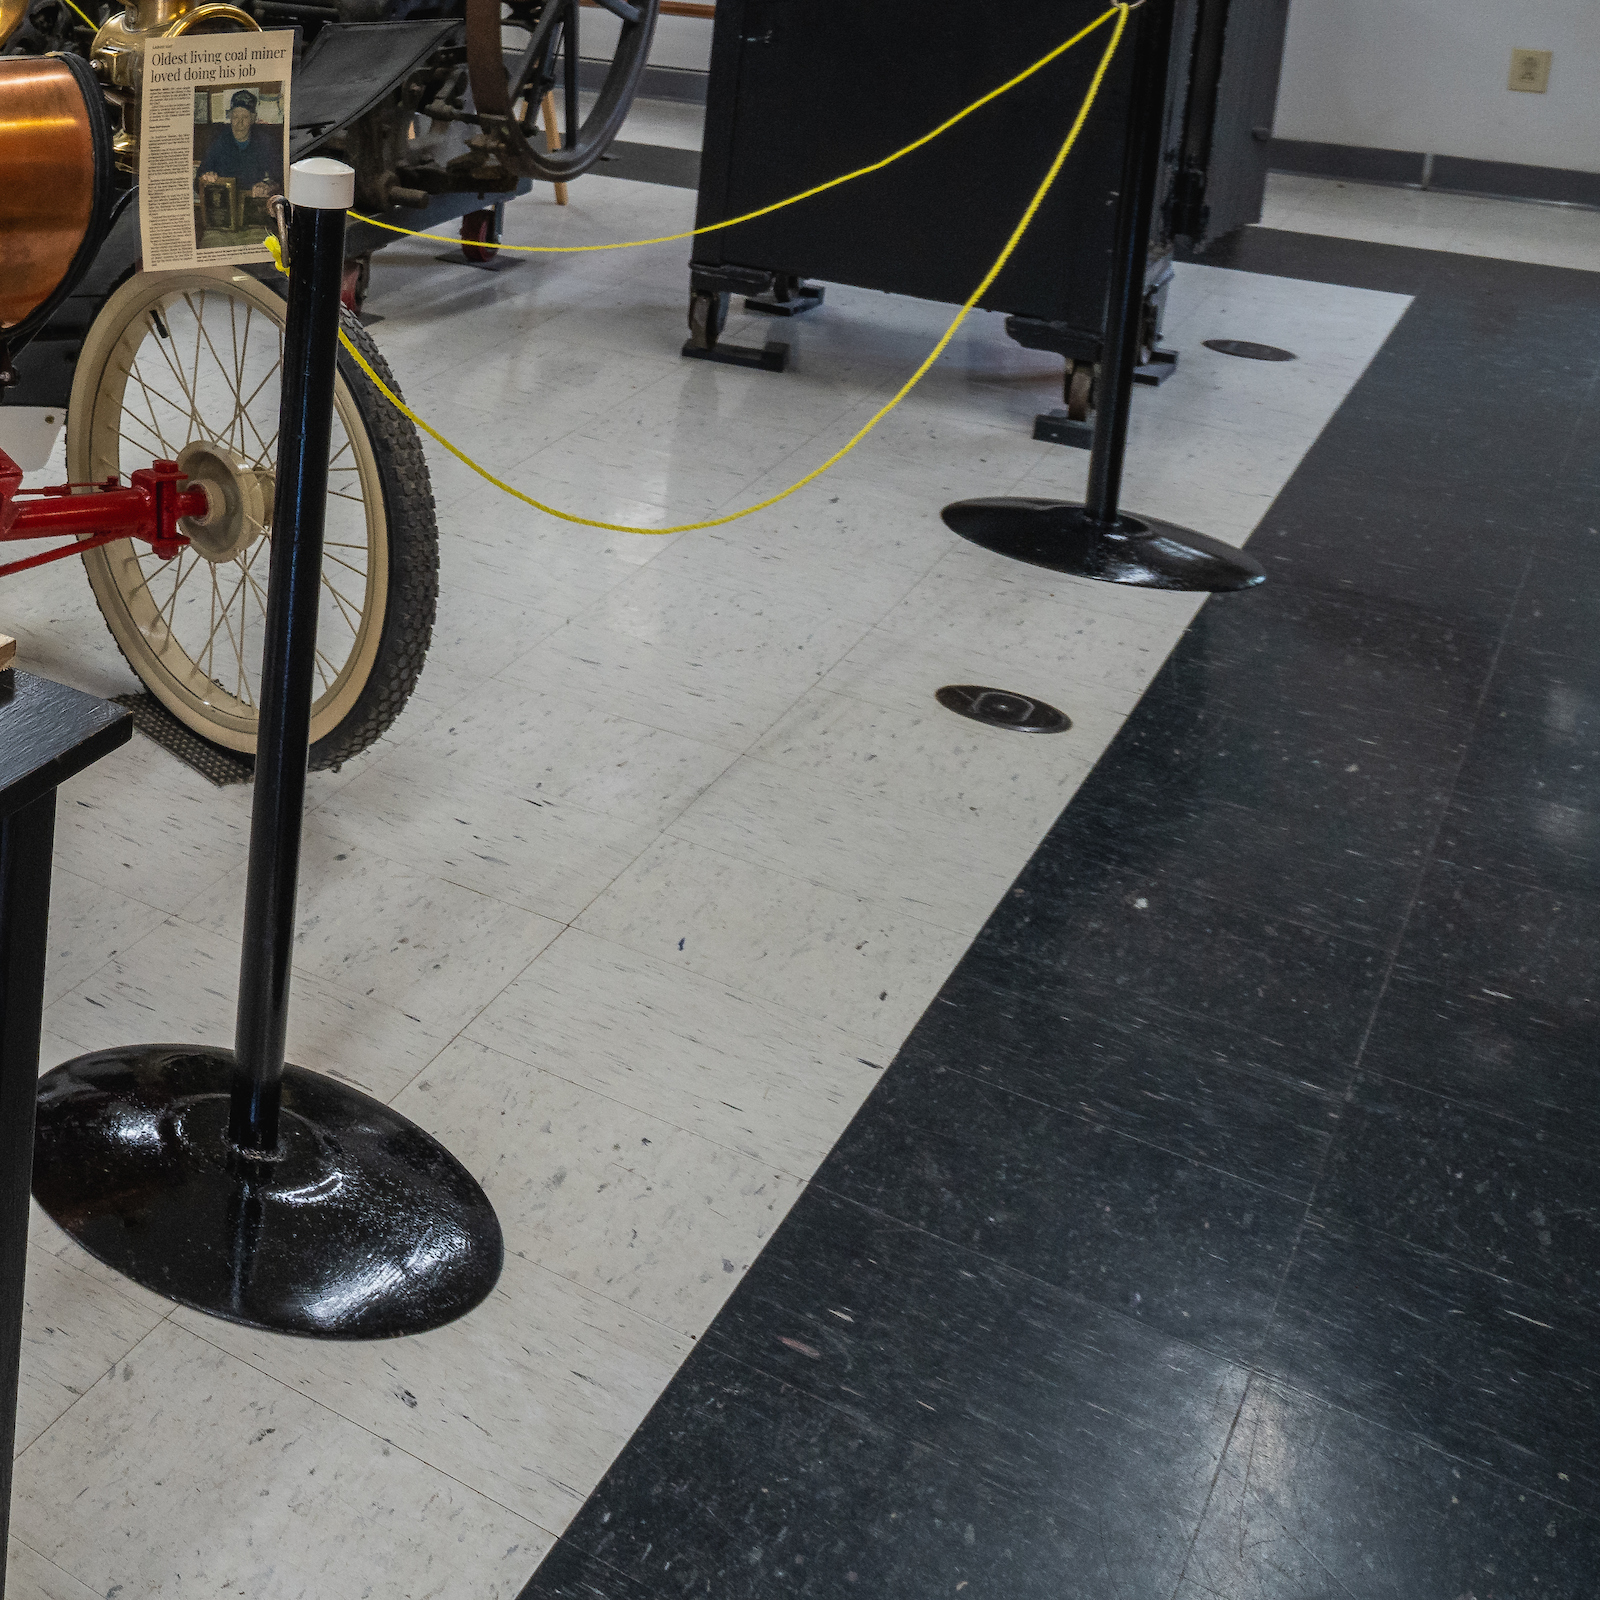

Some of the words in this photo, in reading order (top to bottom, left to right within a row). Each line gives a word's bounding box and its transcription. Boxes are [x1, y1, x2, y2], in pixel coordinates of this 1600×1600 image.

[151, 52, 188, 66] Oldest
[190, 50, 222, 65] living
[224, 48, 248, 62] coal
[251, 46, 287, 60] miner
[150, 68, 181, 82] loved
[184, 66, 216, 81] doing
[219, 65, 236, 79] his
[238, 64, 256, 77] job
